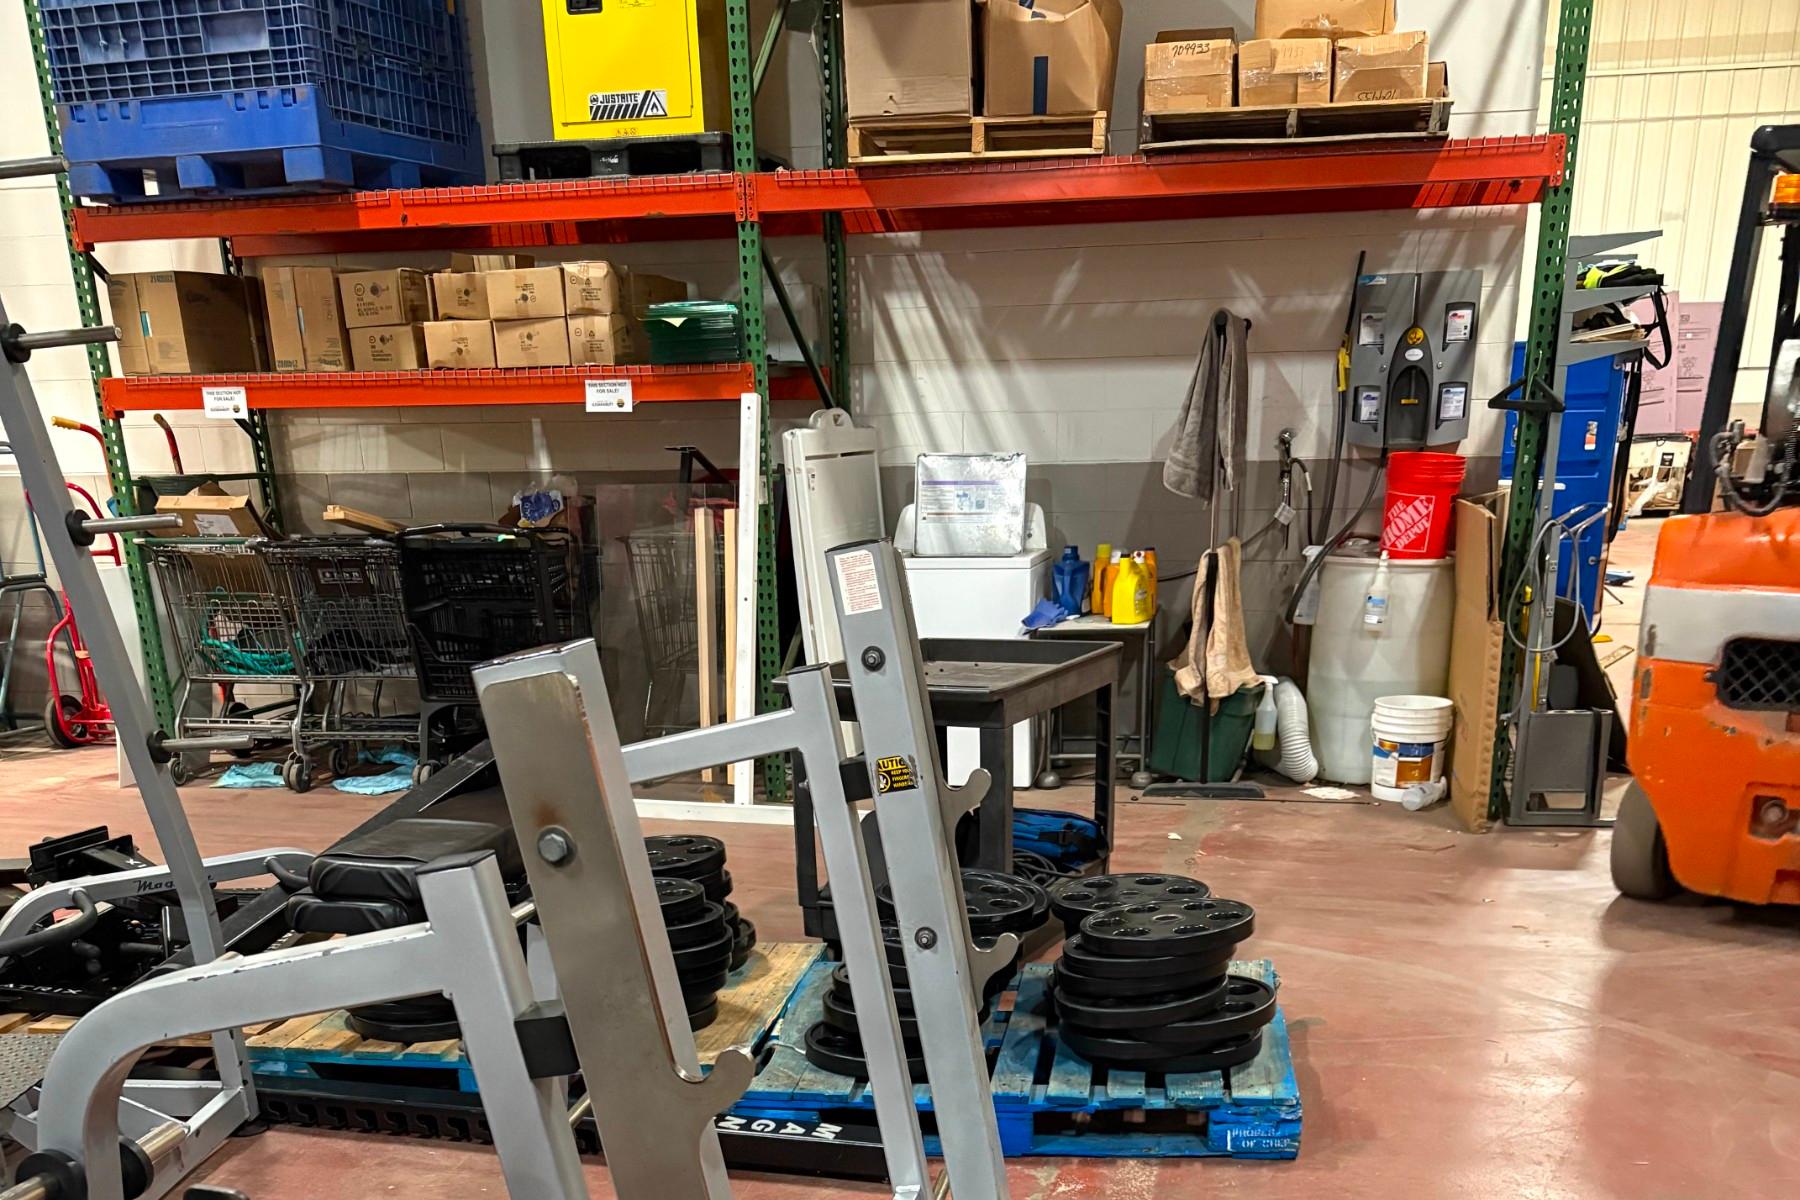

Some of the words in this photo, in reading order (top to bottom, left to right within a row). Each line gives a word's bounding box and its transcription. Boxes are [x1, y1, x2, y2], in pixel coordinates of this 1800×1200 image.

[599, 92, 639, 104] JUSTRITE
[1382, 495, 1433, 548] HOME
[1387, 499, 1407, 521] THE
[1395, 516, 1430, 549] DEPOT
[717, 1115, 843, 1140] MAGN
